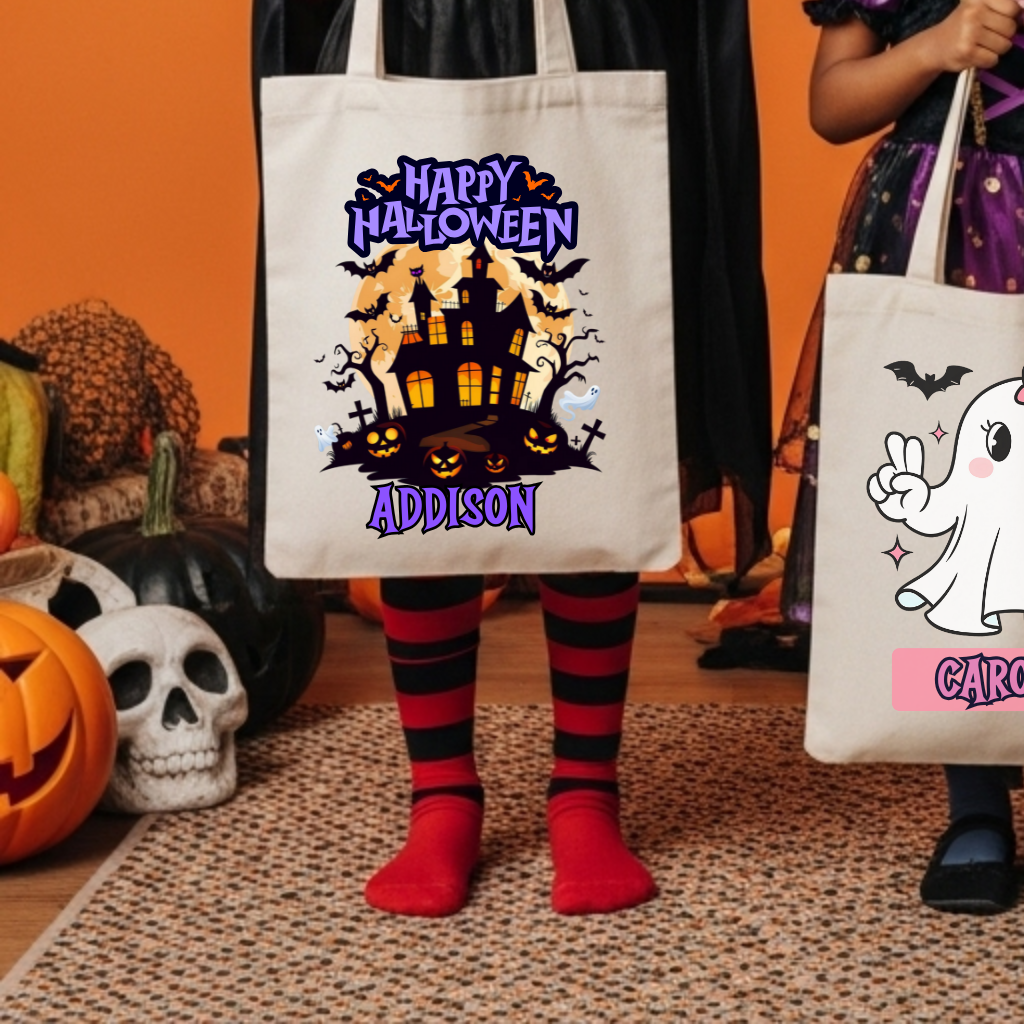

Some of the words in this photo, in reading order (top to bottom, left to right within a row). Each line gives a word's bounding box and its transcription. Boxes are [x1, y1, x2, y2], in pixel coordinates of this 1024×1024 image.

[402, 159, 524, 212] HAPPY
[350, 200, 573, 257] HALLOWEEN
[366, 481, 543, 539] ADDISON
